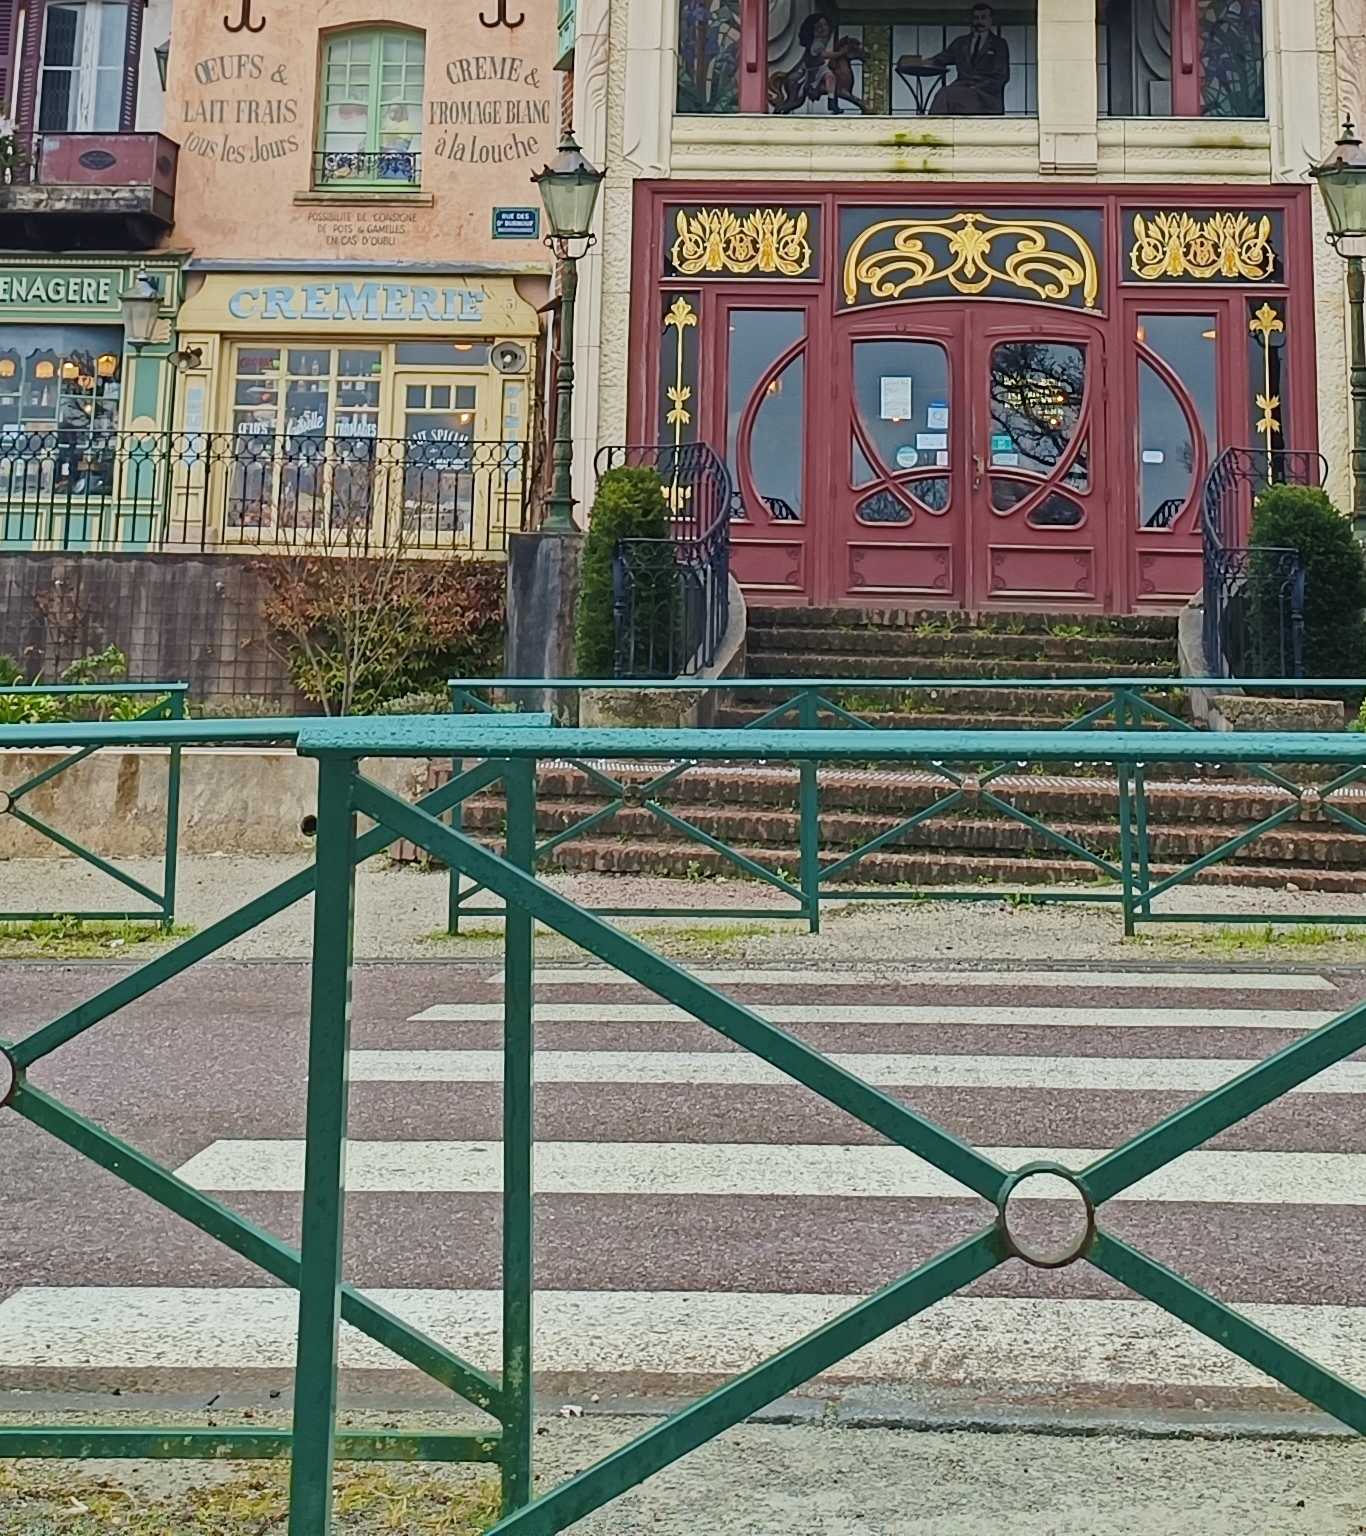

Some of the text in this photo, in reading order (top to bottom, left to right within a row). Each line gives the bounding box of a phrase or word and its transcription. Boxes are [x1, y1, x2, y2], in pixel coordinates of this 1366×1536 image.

[271, 64, 288, 85] &
[446, 56, 540, 88] CREME &
[183, 99, 297, 124] LAIT FRAIS
[428, 100, 550, 124] FROMAGE BLANC
[183, 130, 219, 159] tous
[220, 134, 245, 164] les
[447, 133, 466, 162] la
[469, 133, 540, 163] Louche
[317, 224, 327, 233] DE
[357, 213, 367, 222] DE
[373, 213, 417, 222] CONSIGNE
[341, 235, 357, 245] CAS
[228, 282, 484, 322] CREMERIE
